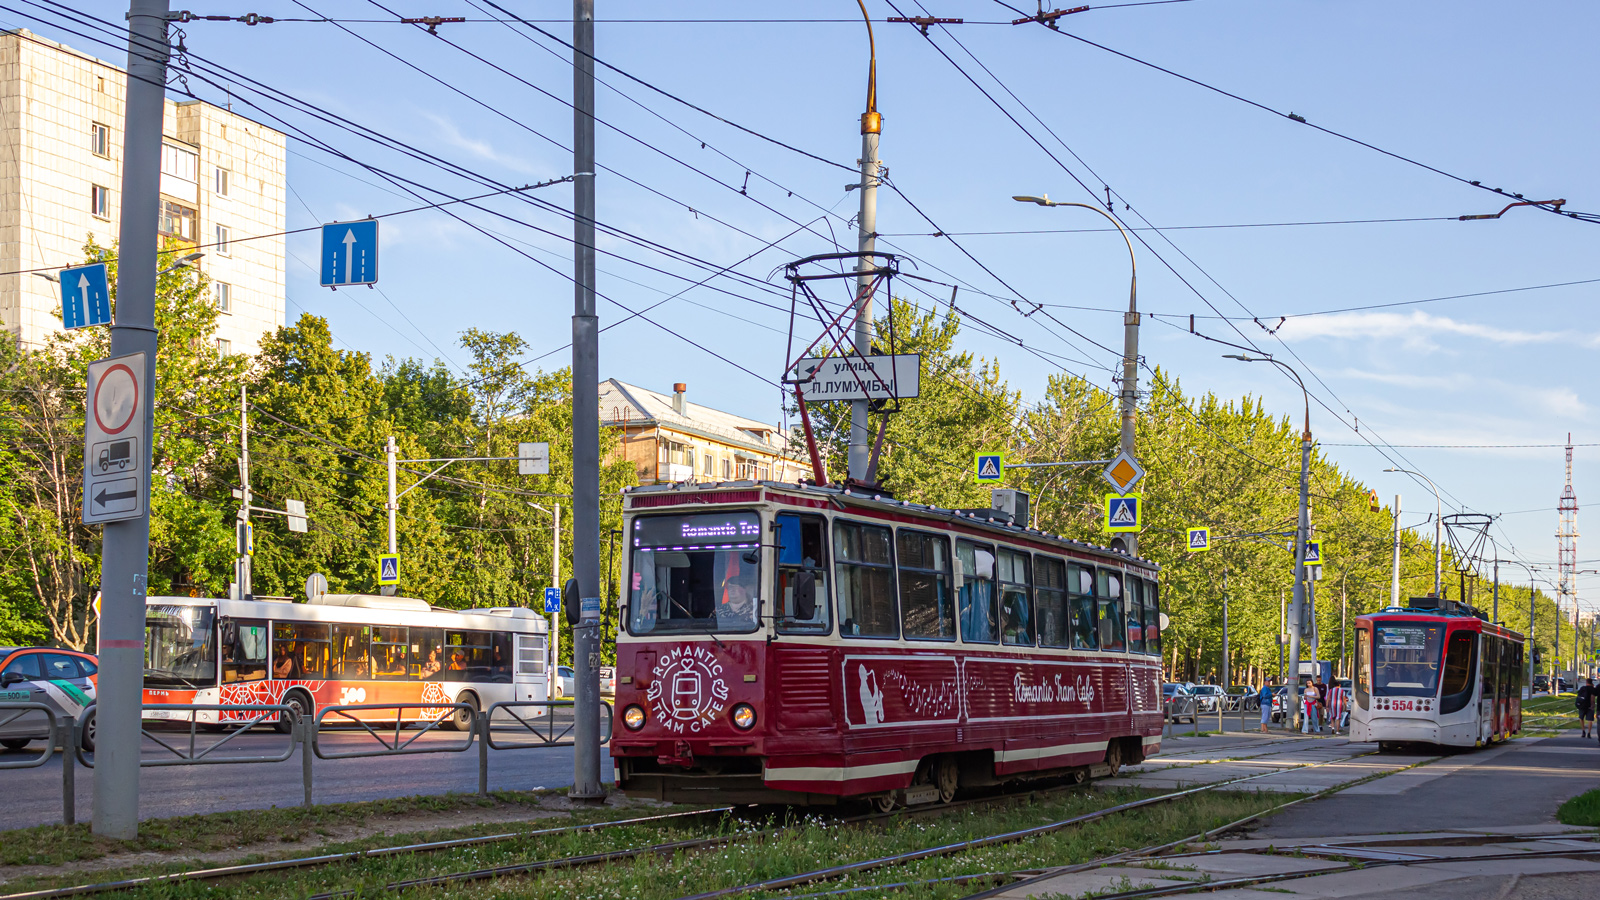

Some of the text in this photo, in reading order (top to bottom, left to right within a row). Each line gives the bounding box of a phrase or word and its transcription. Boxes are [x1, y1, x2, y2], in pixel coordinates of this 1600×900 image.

[833, 361, 875, 375] улица
[812, 379, 894, 394] П.ЛУМУМБЫ
[682, 522, 737, 538] Romantic
[652, 645, 723, 677] ROMANTIC
[1013, 672, 1095, 710] Romantic Tram Cafe
[1392, 700, 1414, 711] 554
[652, 701, 724, 734] TRAM CAFE
